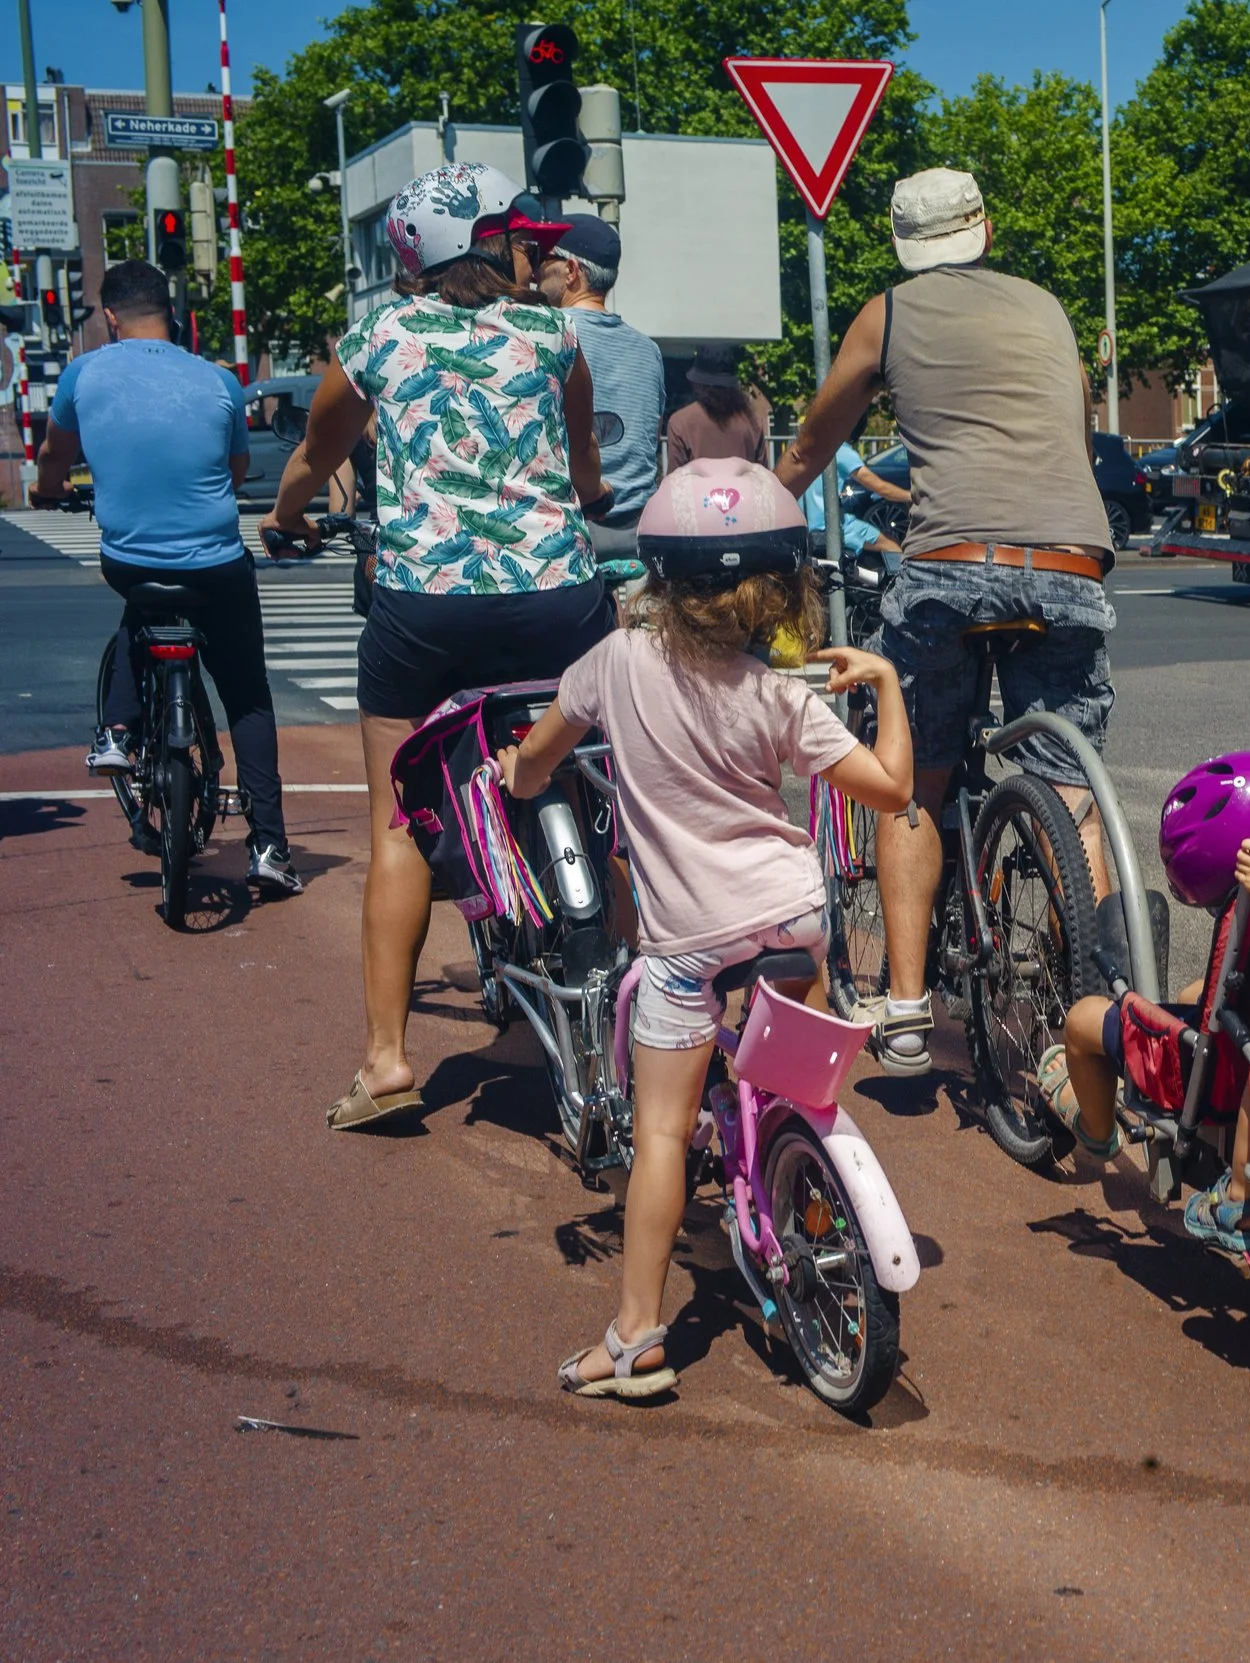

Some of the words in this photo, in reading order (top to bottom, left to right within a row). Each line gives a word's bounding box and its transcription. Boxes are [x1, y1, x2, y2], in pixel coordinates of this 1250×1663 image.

[129, 119, 197, 134] Neherkade
[15, 169, 45, 177] Camera
[18, 208, 67, 216] automatisch
